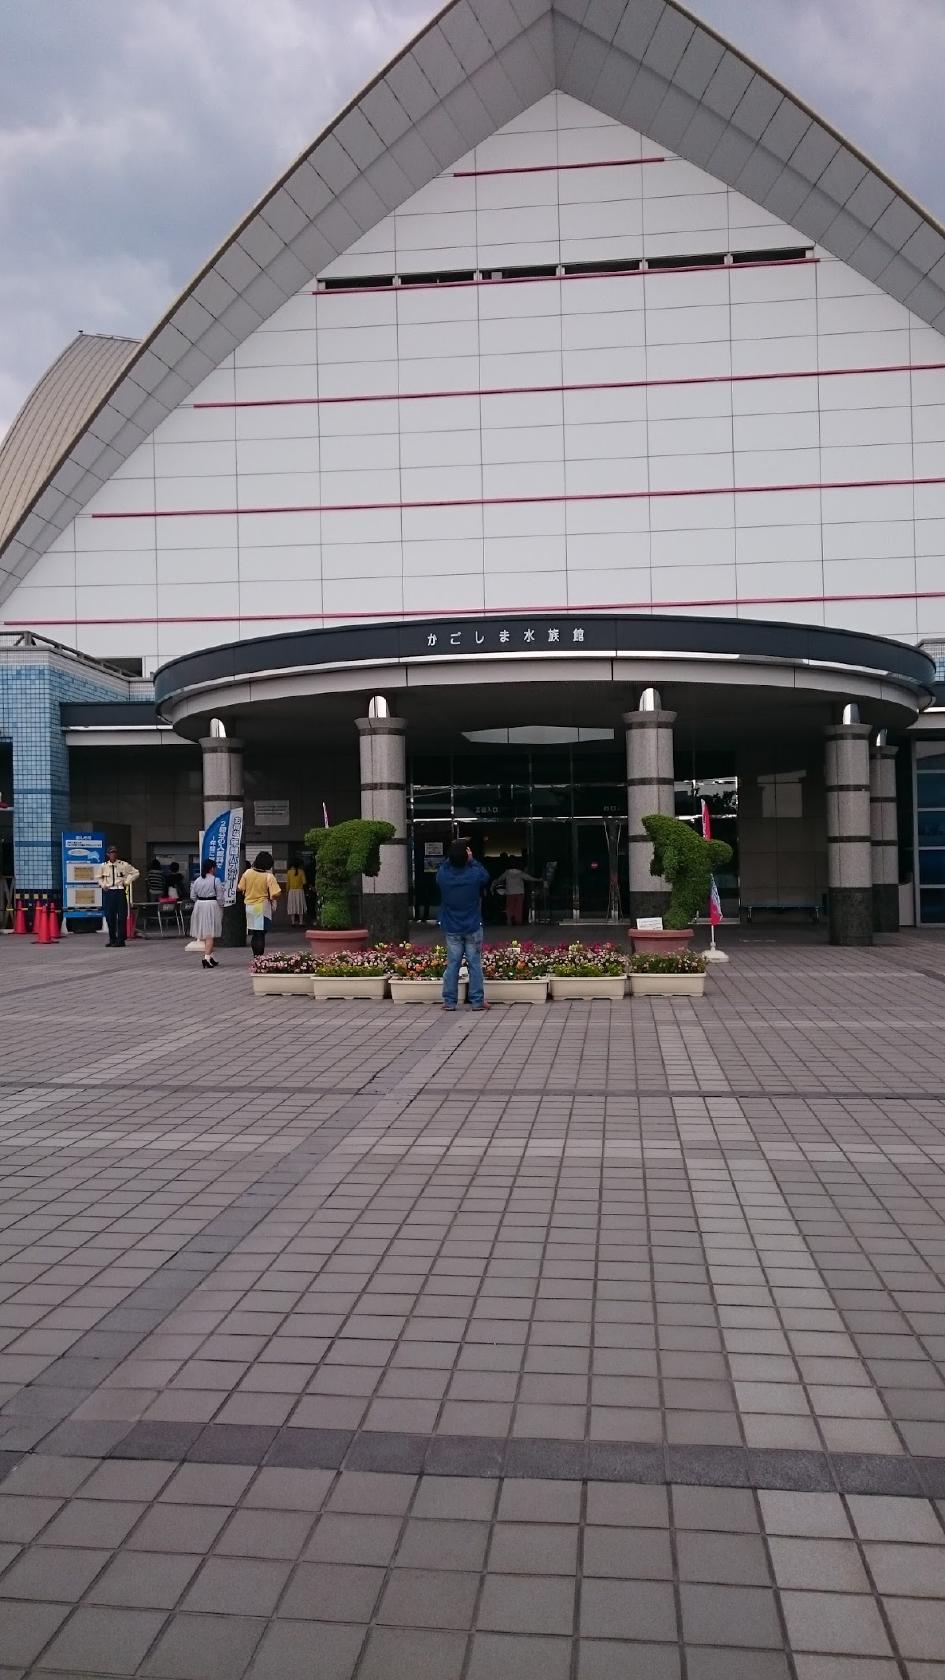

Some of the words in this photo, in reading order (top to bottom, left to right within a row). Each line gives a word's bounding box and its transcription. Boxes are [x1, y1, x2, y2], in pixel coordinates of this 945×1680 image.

[428, 628, 585, 646] かごしま水族館
